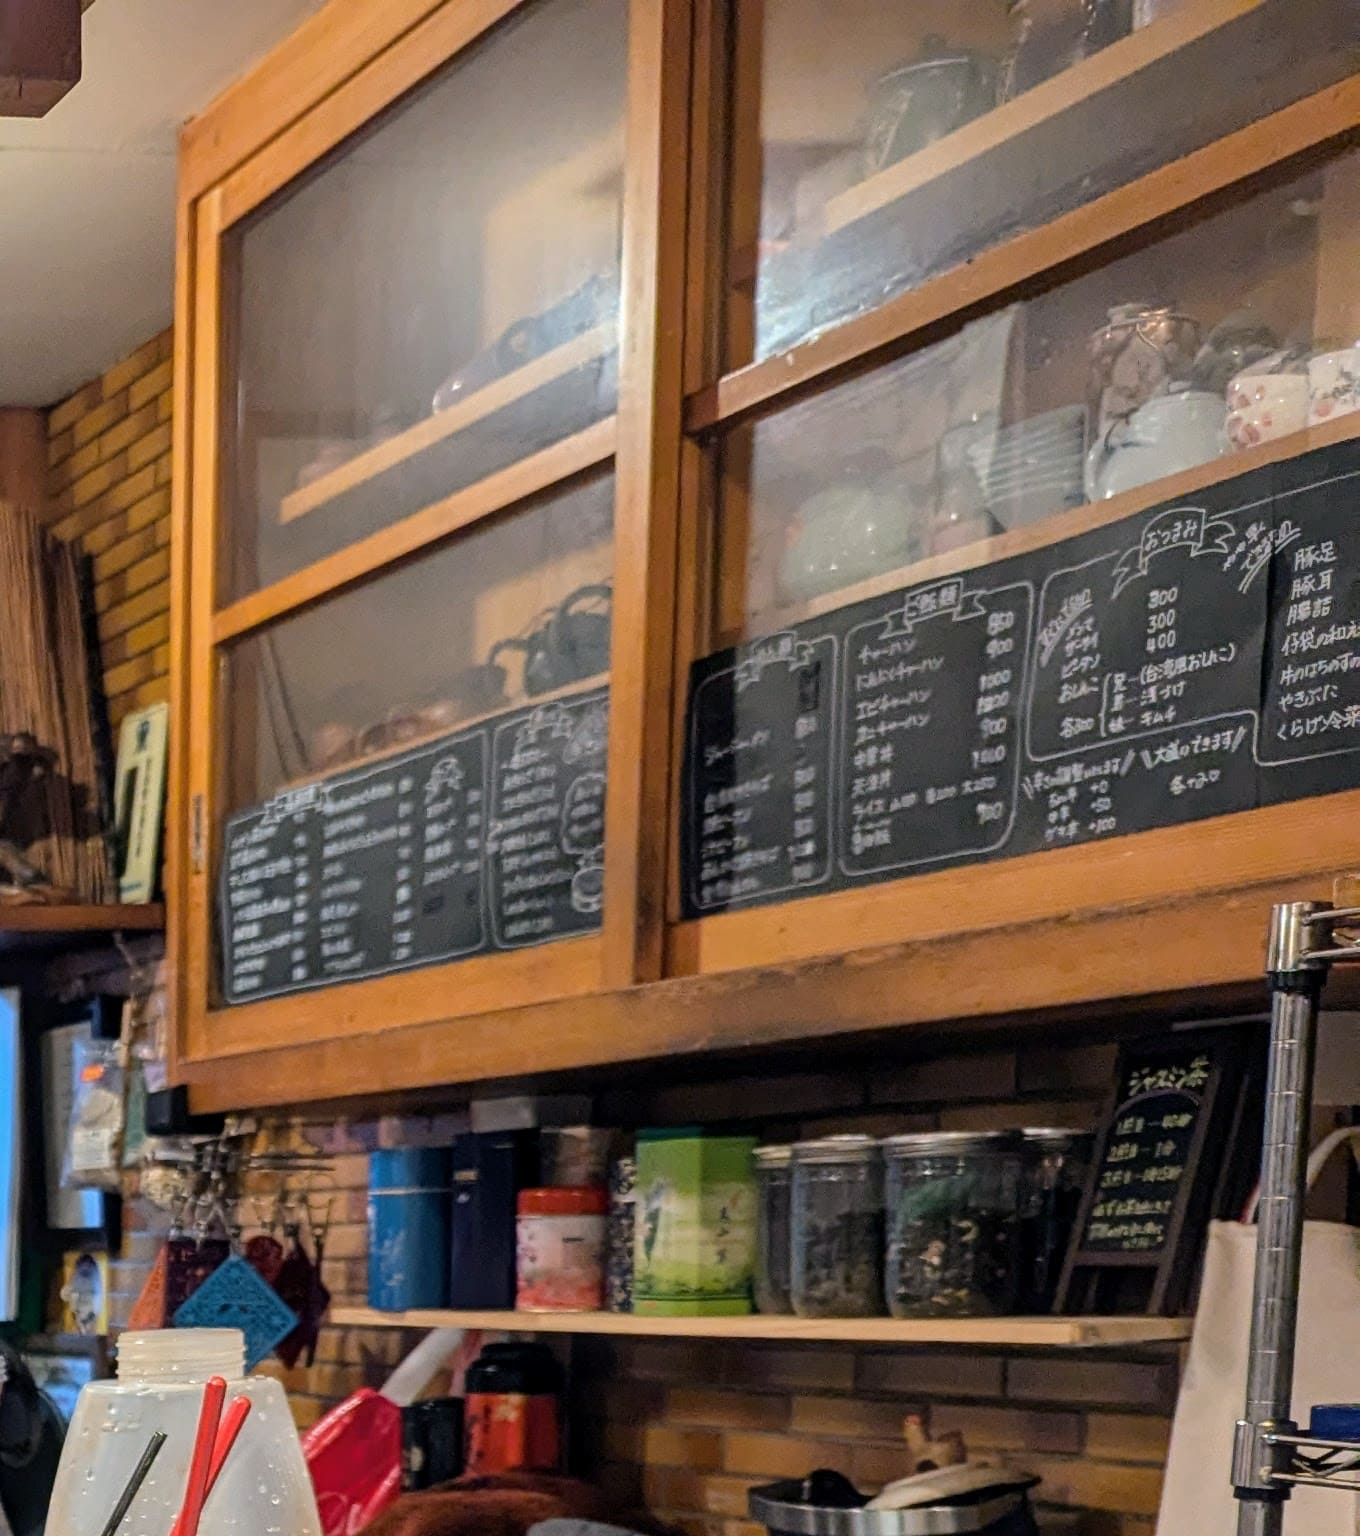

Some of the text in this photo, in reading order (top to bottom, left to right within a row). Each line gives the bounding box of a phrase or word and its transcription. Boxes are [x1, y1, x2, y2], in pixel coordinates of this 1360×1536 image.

[1146, 520, 1198, 551] おつまみ
[1294, 540, 1337, 571] 豚足
[1291, 569, 1333, 599] 豚耳
[1148, 587, 1179, 609] 300
[1147, 610, 1176, 632] 300
[1147, 631, 1176, 653] 400
[1279, 685, 1337, 712] やきぶた
